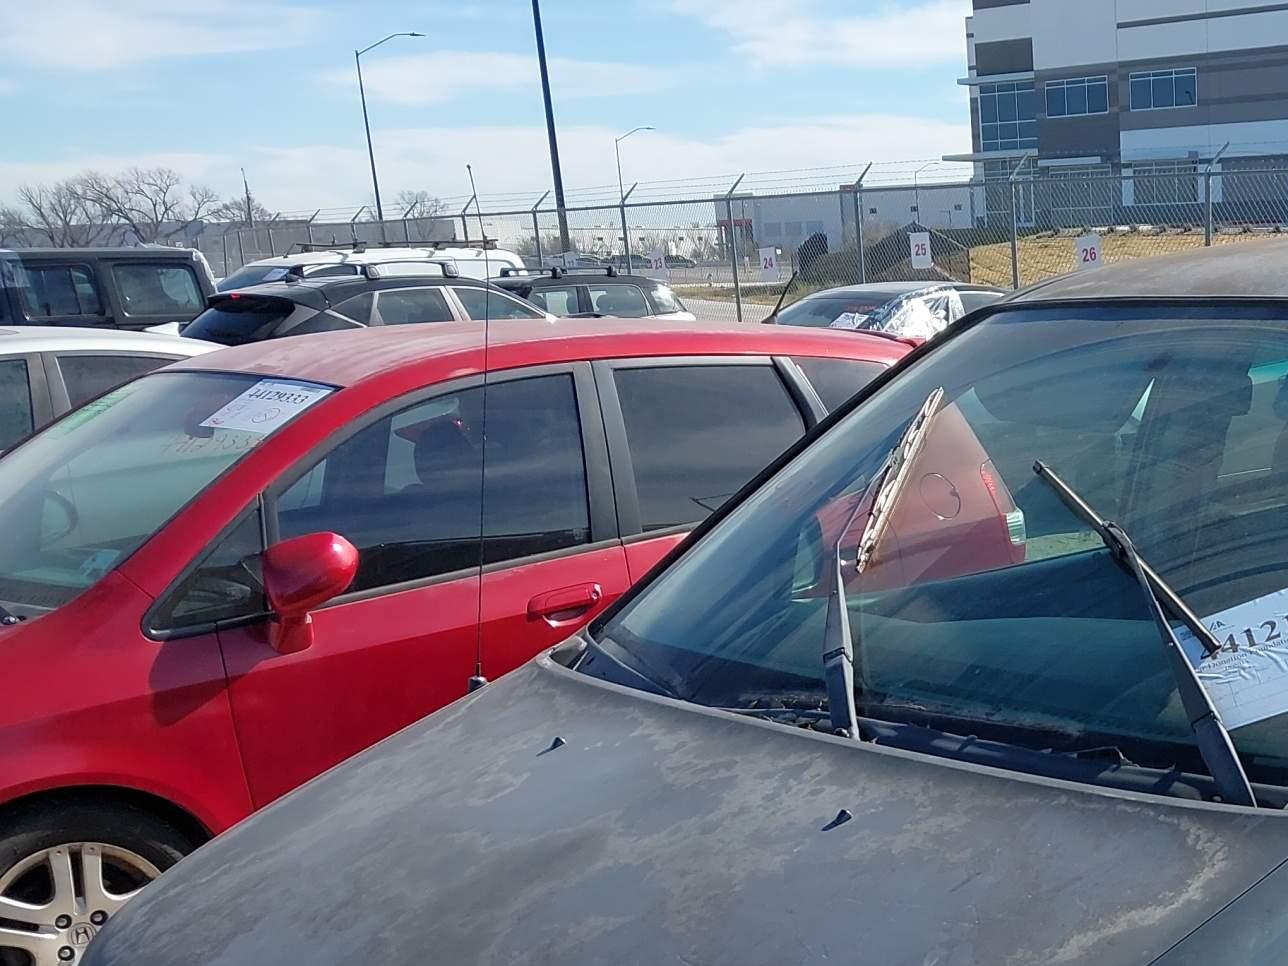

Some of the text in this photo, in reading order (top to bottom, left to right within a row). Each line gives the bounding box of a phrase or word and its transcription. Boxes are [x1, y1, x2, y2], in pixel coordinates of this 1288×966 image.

[914, 243, 927, 257] 25
[1081, 247, 1097, 262] 26
[653, 257, 663, 270] 23
[763, 257, 774, 270] 24
